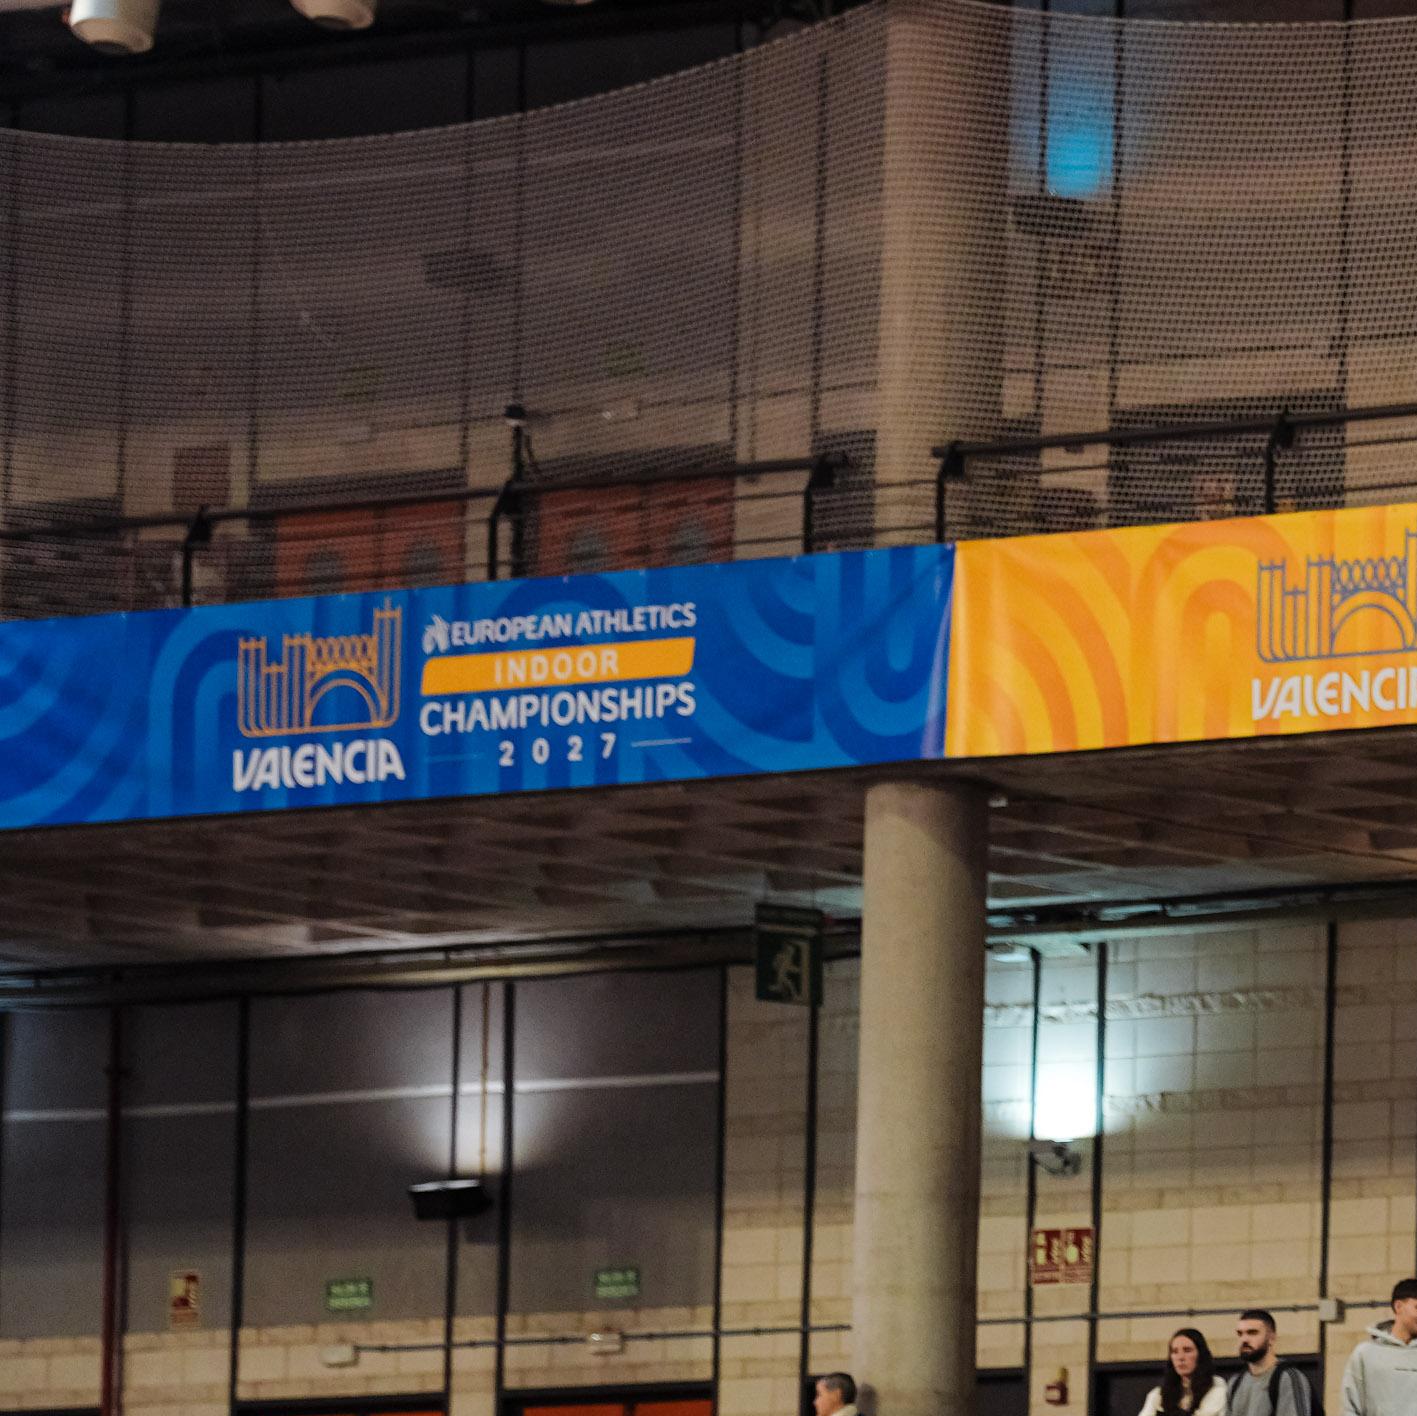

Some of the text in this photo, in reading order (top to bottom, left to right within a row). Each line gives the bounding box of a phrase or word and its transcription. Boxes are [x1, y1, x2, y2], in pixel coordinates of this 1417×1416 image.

[452, 602, 697, 646] EUROPEAN ATHLETICS
[494, 649, 620, 684] INDOOR
[419, 681, 697, 736] CHAMPIONSHIPS
[232, 738, 405, 792] VALENCIA
[499, 732, 617, 767] 2027
